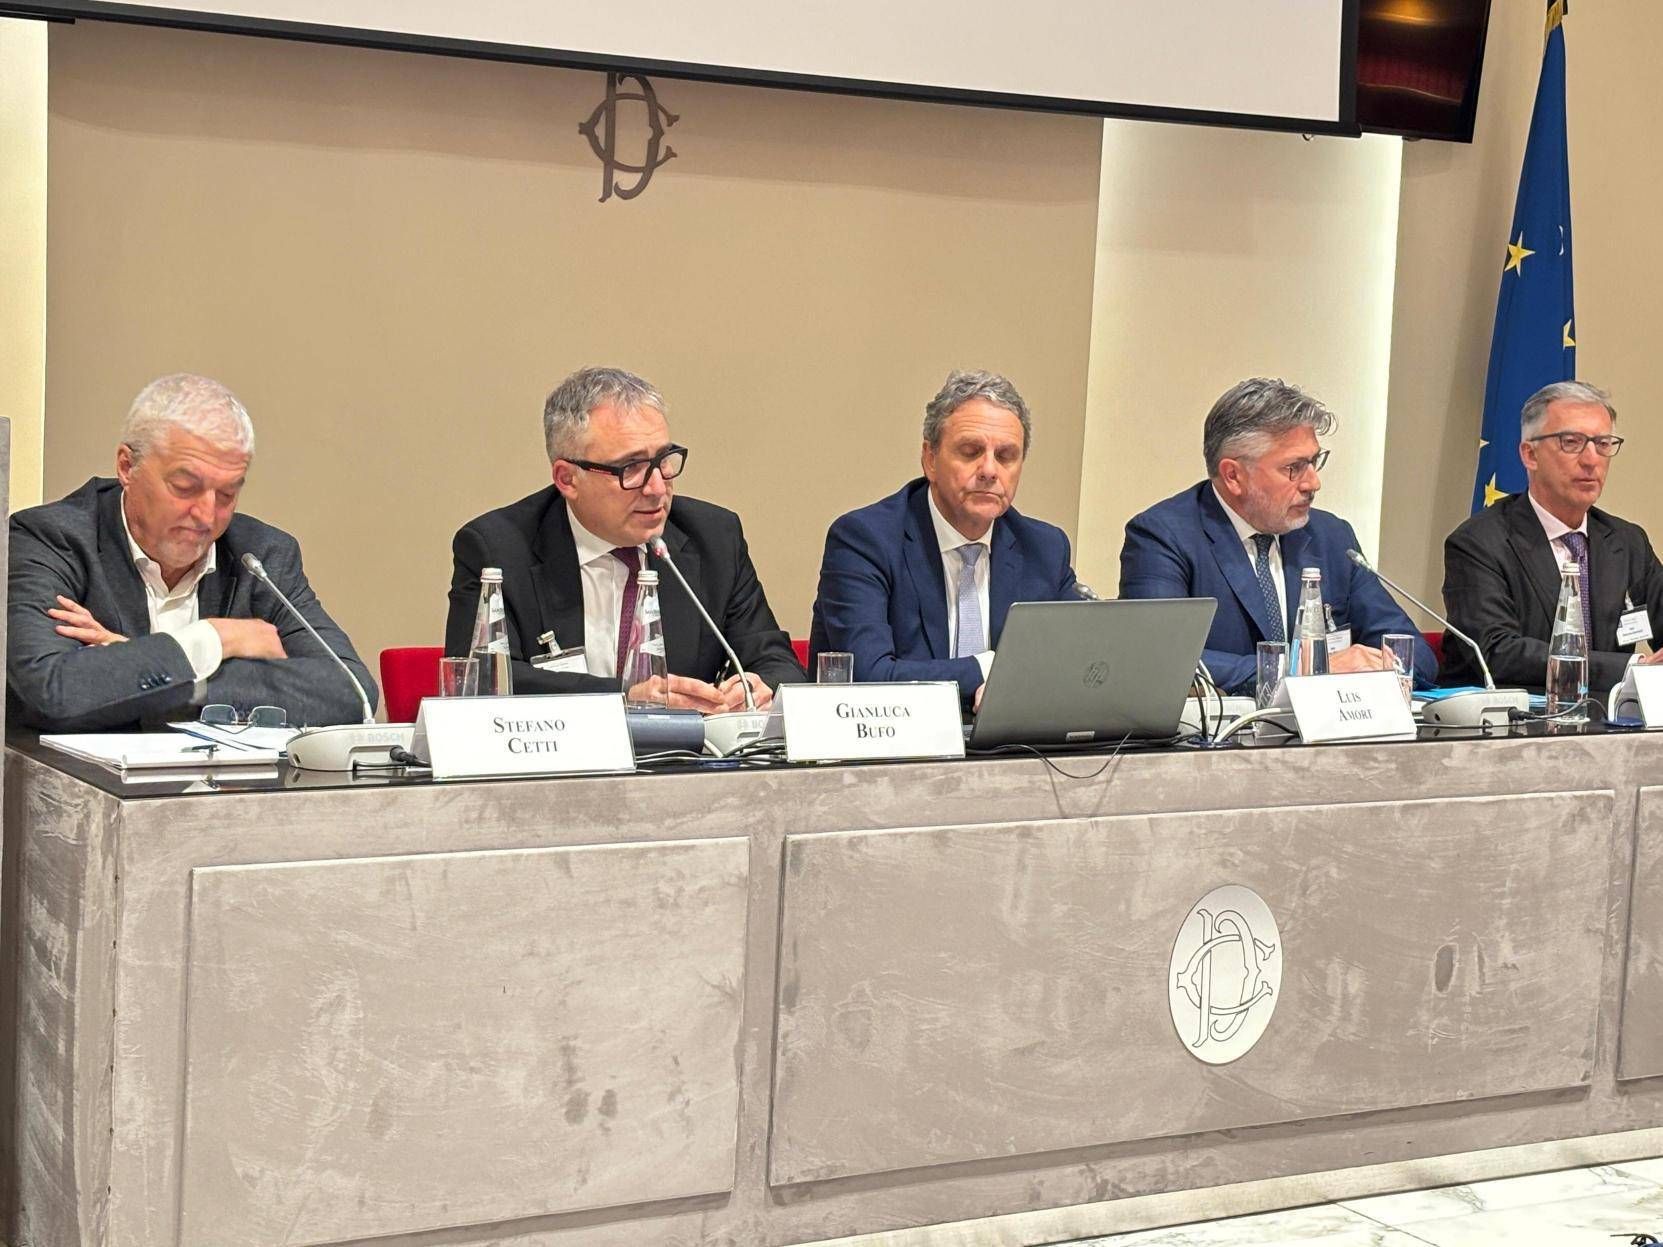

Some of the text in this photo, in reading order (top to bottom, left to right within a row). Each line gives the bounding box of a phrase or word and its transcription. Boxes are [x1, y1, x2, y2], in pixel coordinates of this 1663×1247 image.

[836, 702, 911, 719] GIANLUCA
[493, 716, 565, 734] STEFANO
[856, 722, 896, 739] BUFO
[508, 737, 558, 754] CETTI
